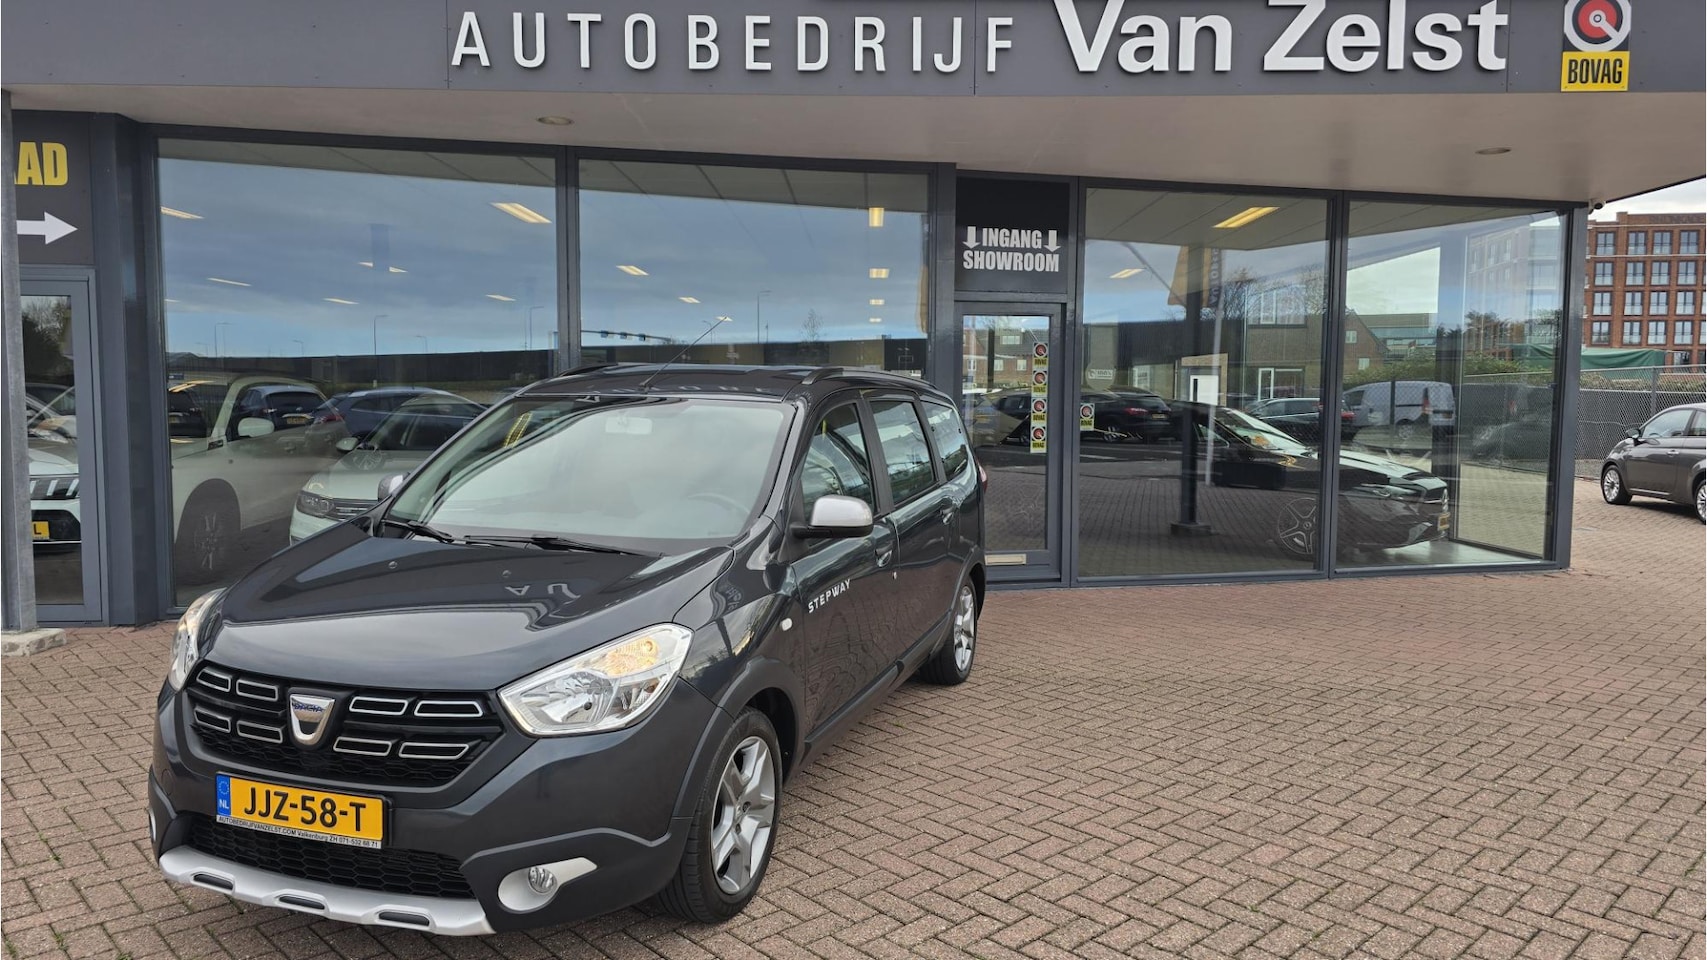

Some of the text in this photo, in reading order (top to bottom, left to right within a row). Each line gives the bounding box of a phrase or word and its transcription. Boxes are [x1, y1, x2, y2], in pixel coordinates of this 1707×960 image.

[451, 11, 1013, 73] AUTOBEDRIJF
[1053, 0, 1509, 73] Van Zelst
[1567, 58, 1623, 84] BOVAG
[14, 141, 69, 186] AD
[982, 227, 1042, 249] INGANG
[963, 250, 1060, 272] SHOWROOM
[808, 578, 850, 614] STEPWAY
[218, 798, 229, 809] NL
[244, 787, 367, 832] JJZ-58-T
